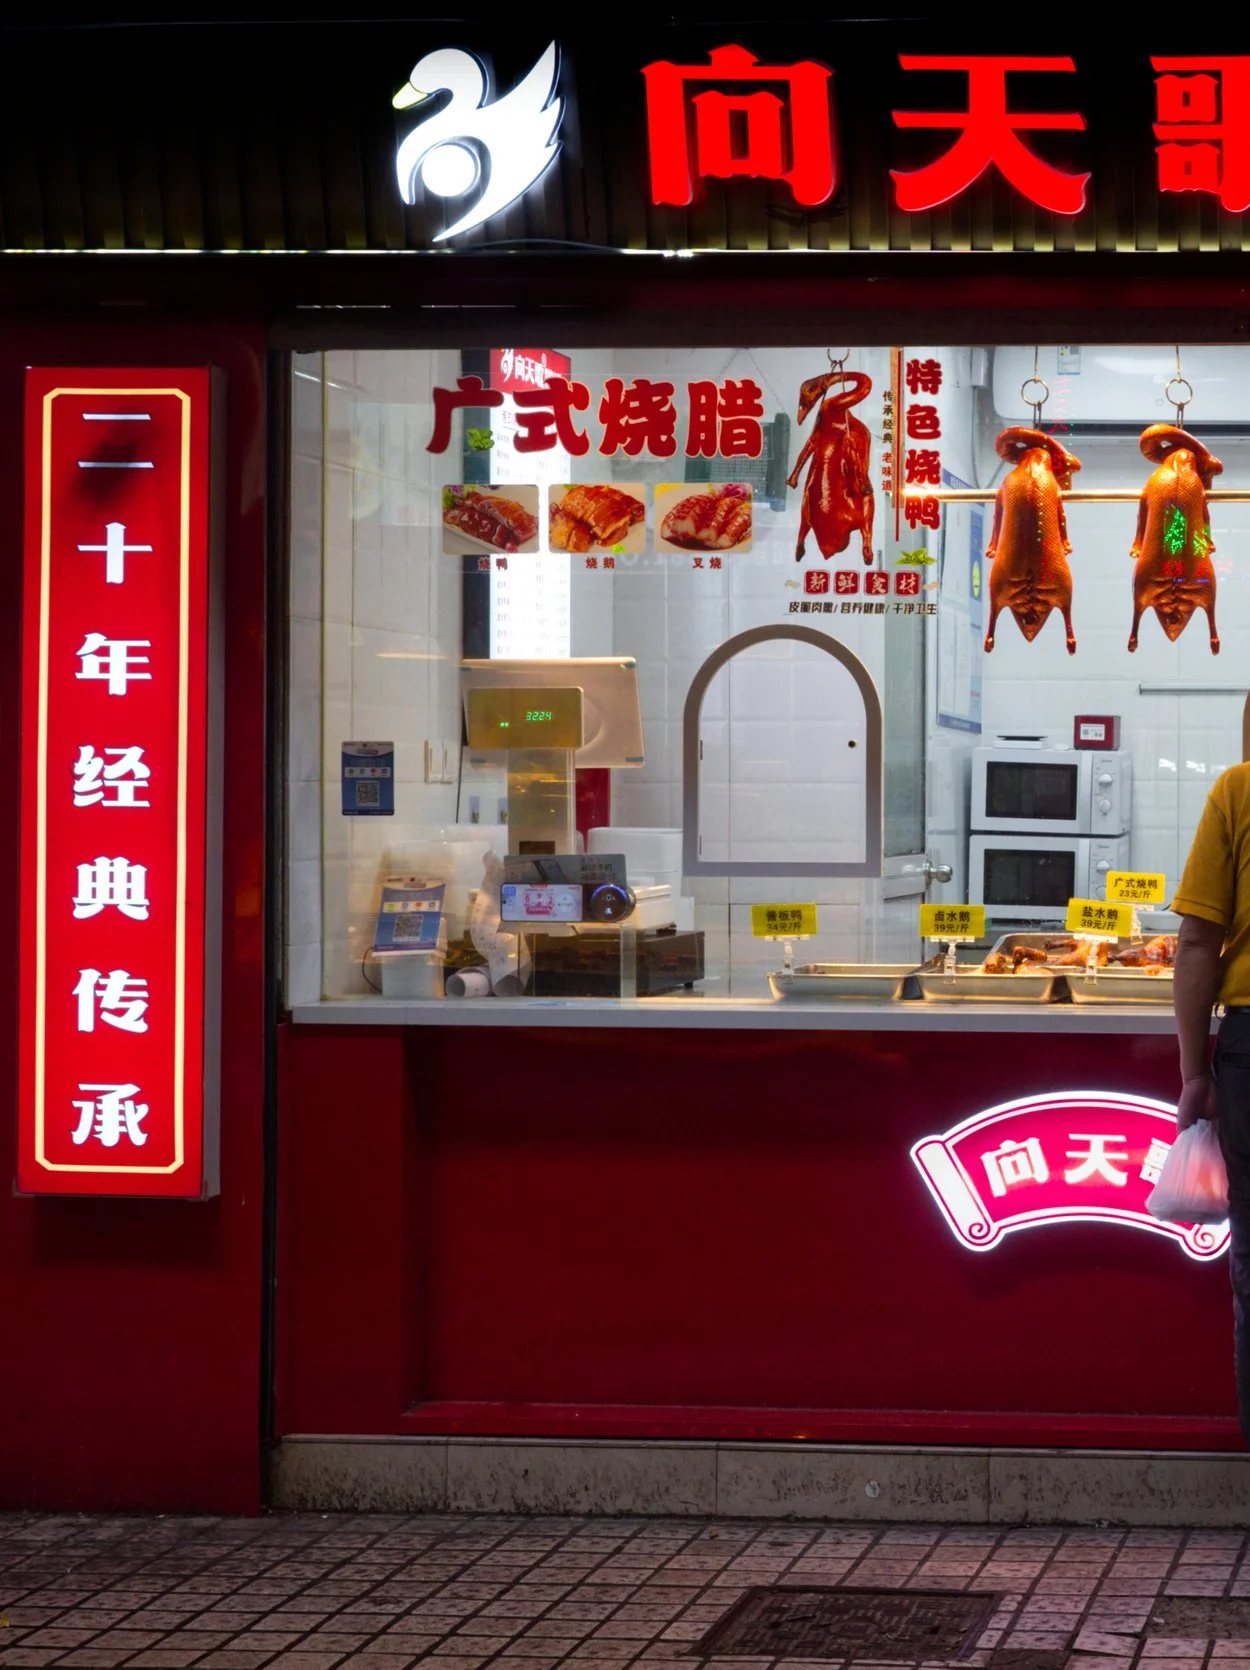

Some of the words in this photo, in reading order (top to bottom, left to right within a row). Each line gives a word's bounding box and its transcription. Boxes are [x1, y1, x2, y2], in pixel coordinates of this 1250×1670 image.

[425, 375, 765, 460] 广式烧腊
[882, 390, 894, 444] 传承经典
[904, 358, 943, 531] 特色烧鸭
[881, 451, 893, 492] 老味道
[478, 557, 508, 571] 烧鸭
[585, 557, 616, 571] 烧鹅
[692, 557, 722, 571] 叉烧
[806, 572, 918, 595] 新鲜食材
[72, 412, 154, 1147] 二十年经典传承
[1114, 877, 1158, 889] 广式烧鸭
[1119, 889, 1152, 899] 23元/斤
[934, 910, 970, 922] 卤水鹅
[1082, 905, 1118, 920] 盐水鹅
[934, 922, 970, 933] 39元/斤
[1080, 919, 1117, 931] 39元/斤
